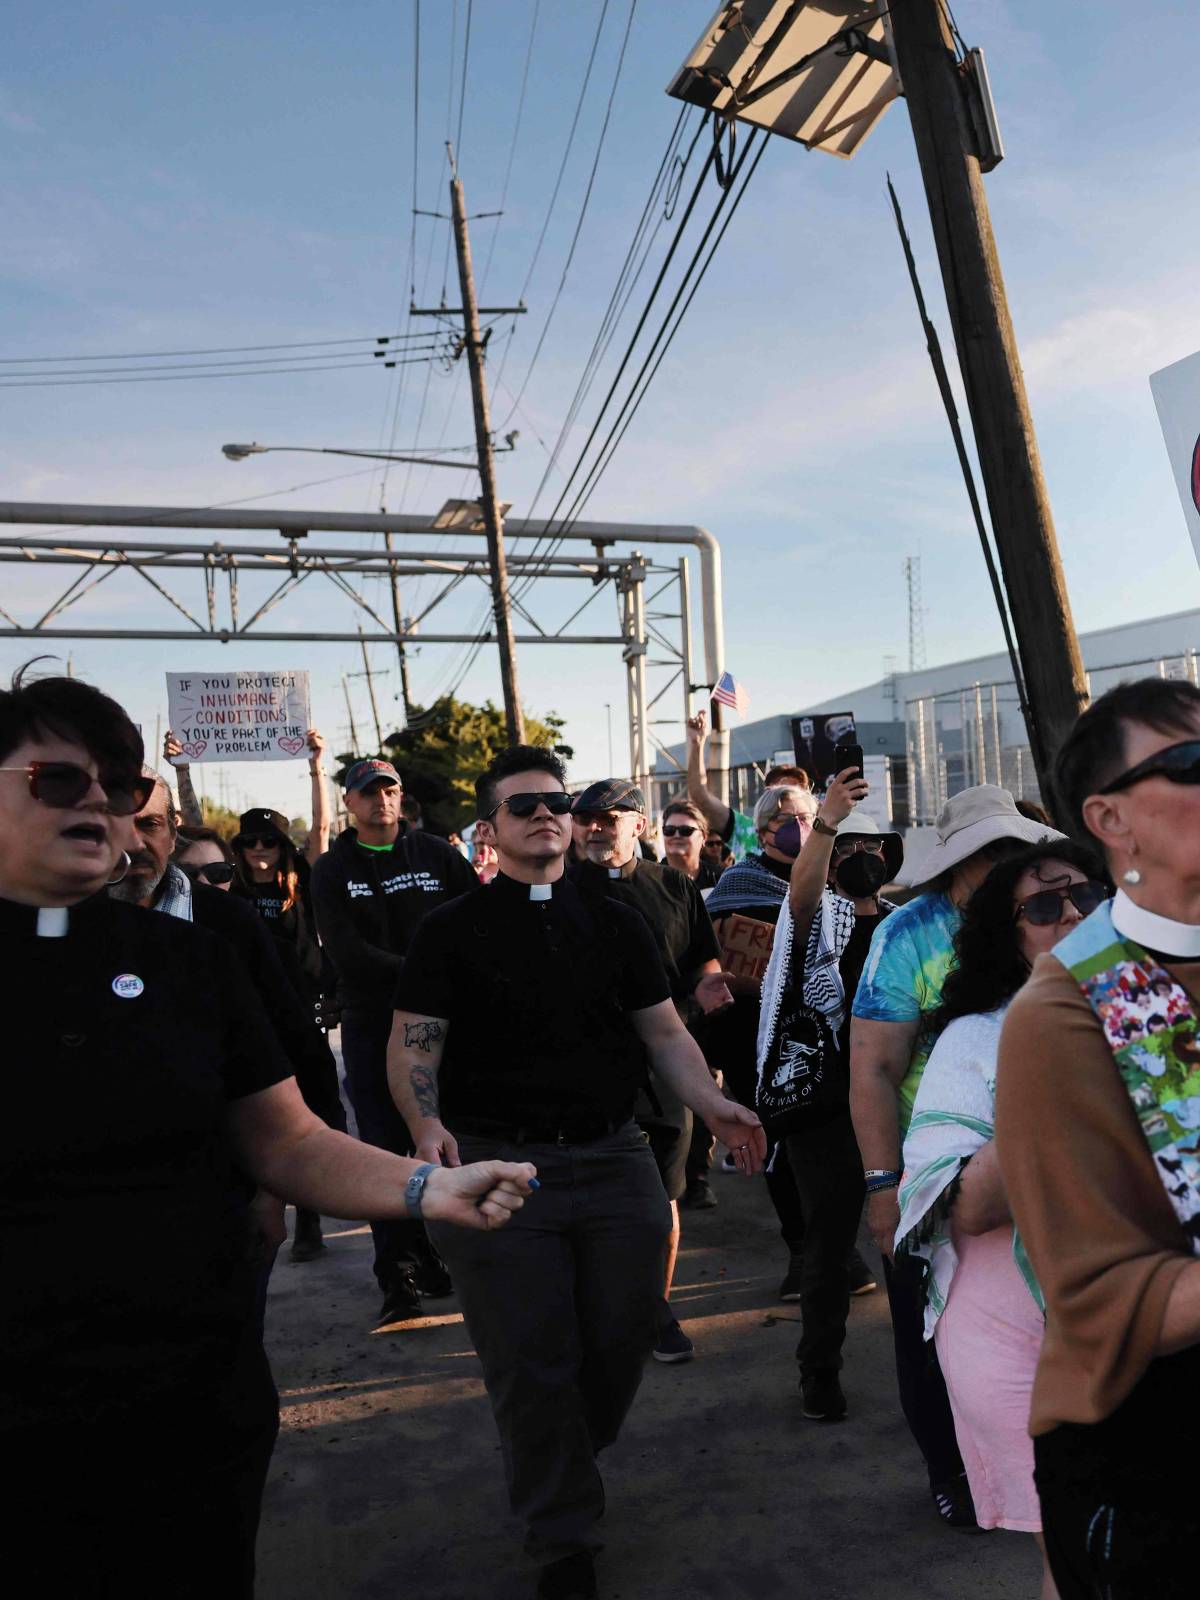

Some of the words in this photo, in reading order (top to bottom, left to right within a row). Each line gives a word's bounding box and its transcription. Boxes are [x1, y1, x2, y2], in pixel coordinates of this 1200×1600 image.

[180, 680, 191, 692] IF
[201, 679, 230, 690] YOU
[237, 676, 296, 690] PROTECT
[200, 692, 278, 707] INHUMANE
[196, 708, 288, 725] CONDITIONS
[182, 727, 227, 741] YOU'RE
[232, 727, 261, 739] PART
[266, 726, 279, 738] OF
[283, 725, 302, 737] THE
[215, 741, 271, 753] PROBLEM
